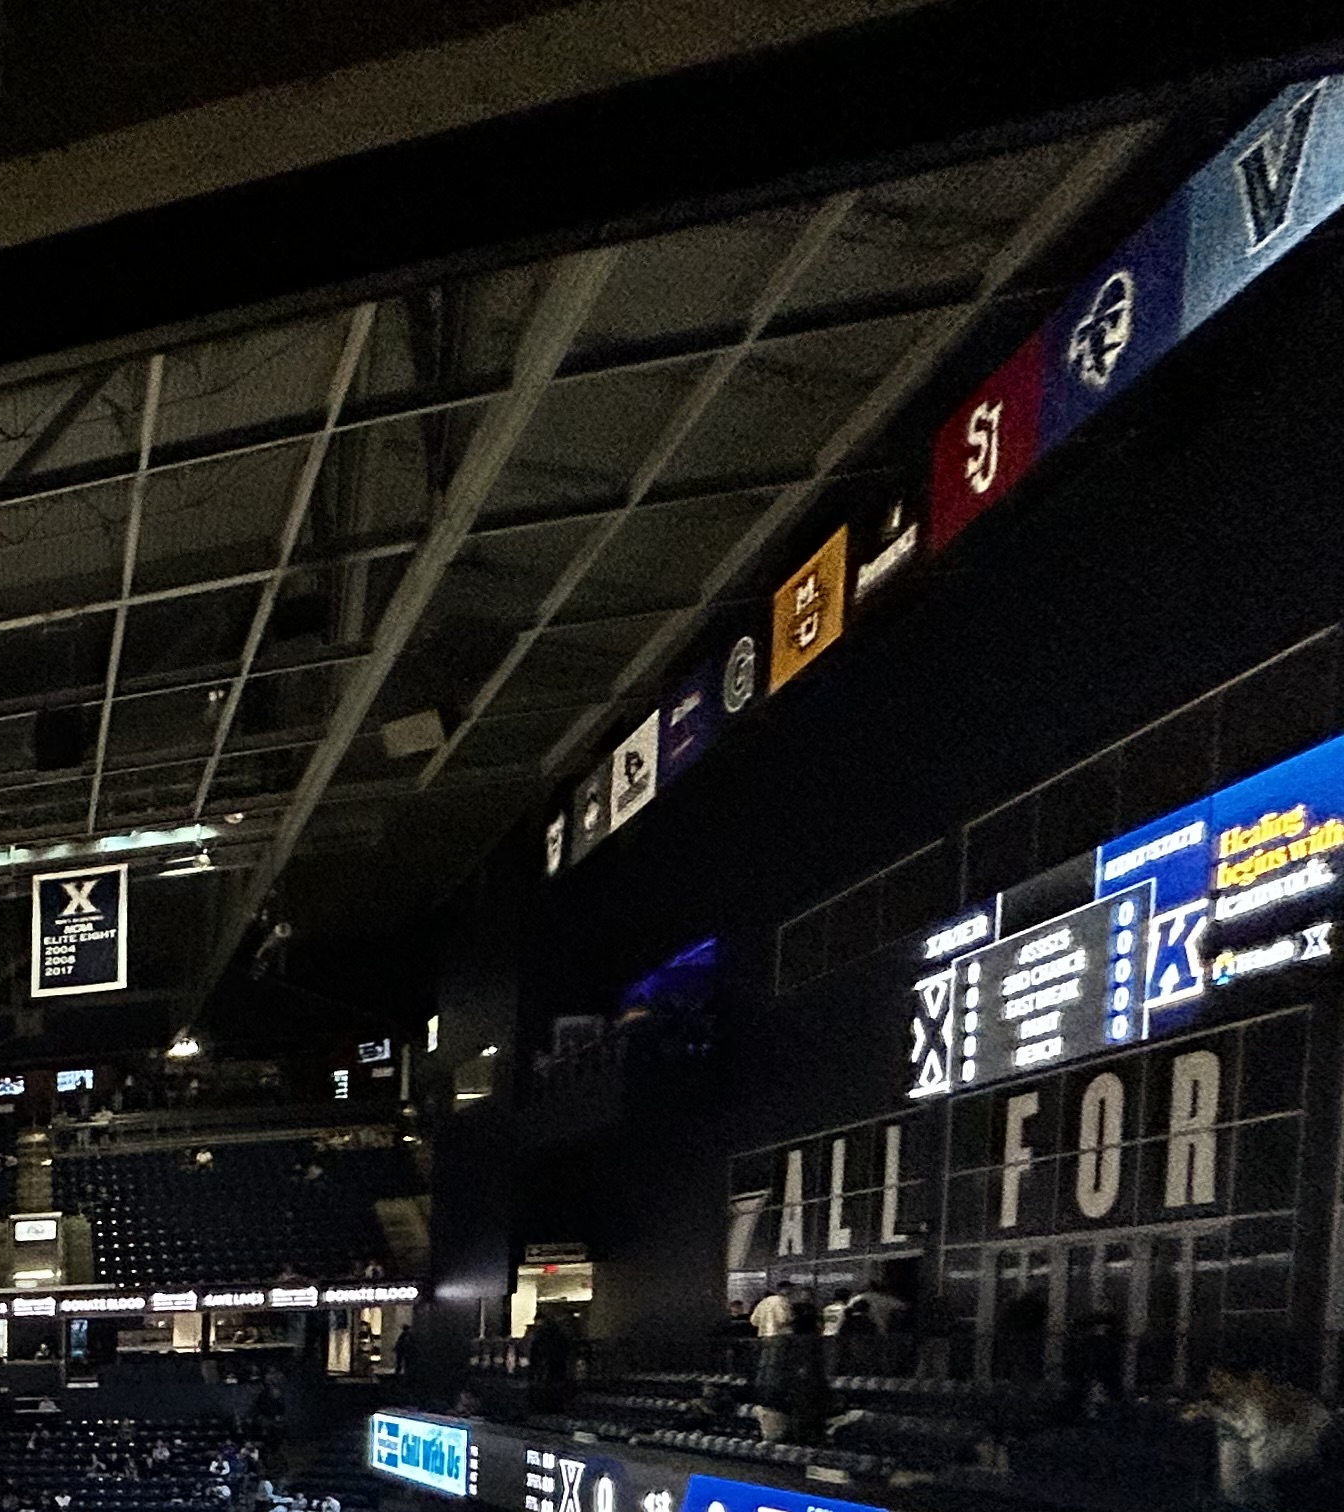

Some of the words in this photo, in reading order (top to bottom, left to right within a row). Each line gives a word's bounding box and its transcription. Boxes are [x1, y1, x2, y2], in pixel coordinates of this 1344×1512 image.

[1217, 803, 1306, 859] Healing
[1216, 846, 1288, 889] begins
[57, 878, 102, 917] X
[1118, 900, 1135, 926] 0
[43, 935, 78, 945] ELITE
[79, 929, 117, 942] EIGHT
[1116, 929, 1133, 954] 0
[44, 944, 76, 956] 2004
[44, 965, 74, 977] 2017
[1115, 958, 1131, 983] 0
[1113, 986, 1130, 1011] 0
[1111, 1014, 1128, 1040] 0
[778, 1125, 908, 1257] ALL
[1000, 1050, 1222, 1229] FOR
